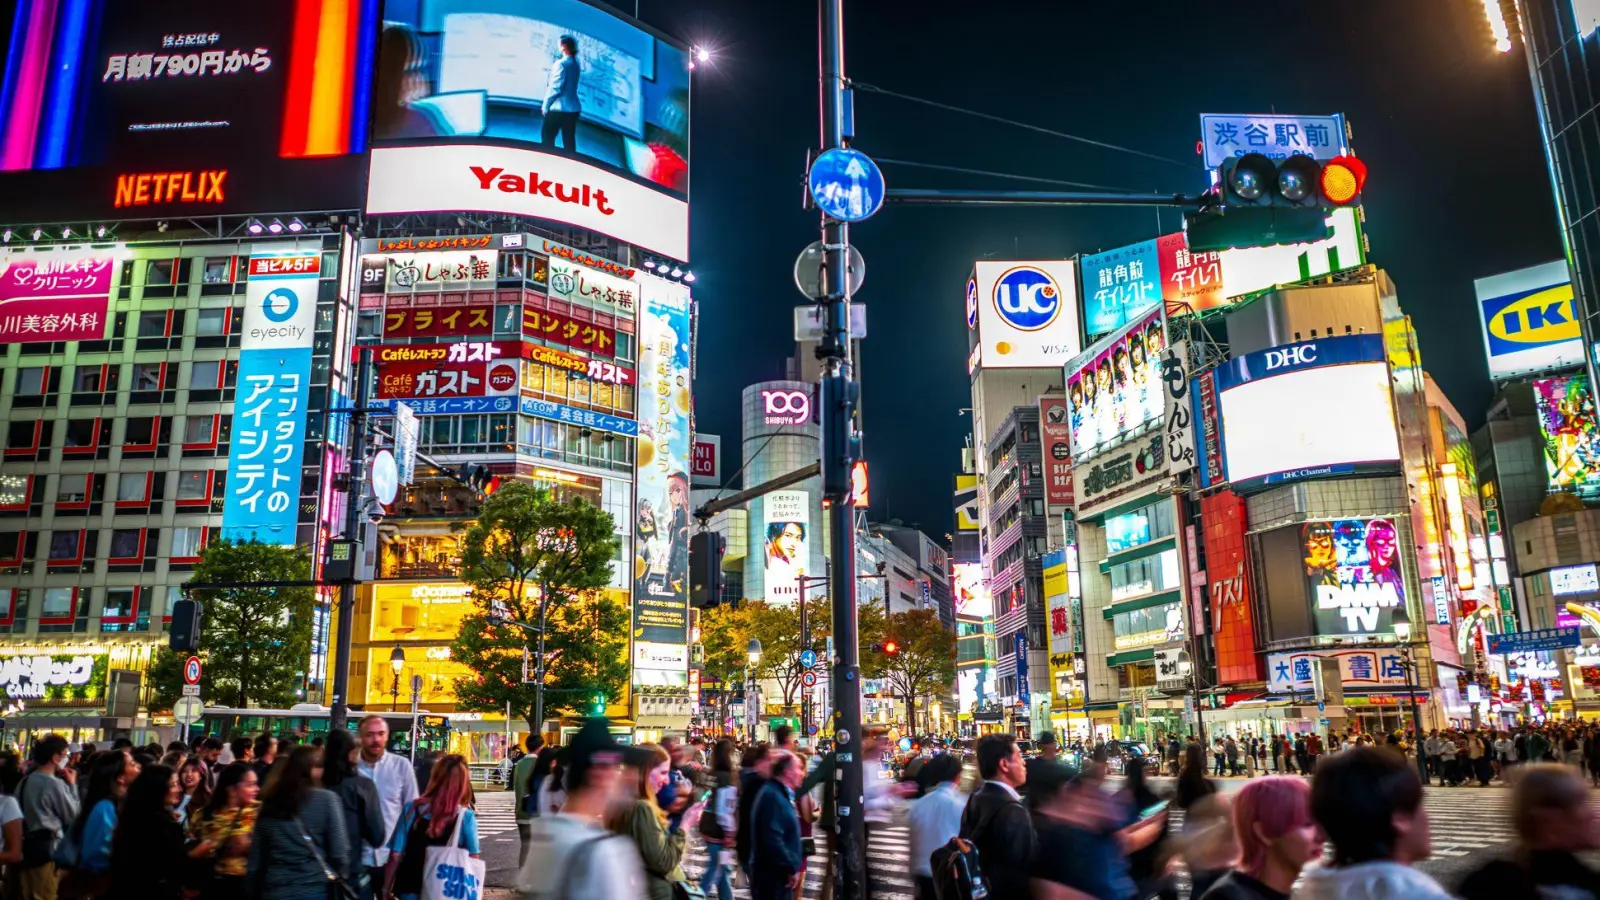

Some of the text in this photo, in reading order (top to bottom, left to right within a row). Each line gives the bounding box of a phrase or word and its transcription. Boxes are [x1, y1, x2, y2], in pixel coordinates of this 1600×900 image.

[162, 33, 220, 48] 独占配信中
[103, 48, 272, 82] 月額790円から
[1214, 123, 1329, 147] 渋谷駅前
[114, 170, 228, 208] NETFLIX
[469, 166, 615, 216] Yakult
[378, 235, 492, 252] しゃぶしゃぶバイキング
[256, 258, 313, 274] 当ビル5F
[364, 268, 384, 282] 9F
[425, 260, 490, 282] しゃぶ葉
[1098, 259, 1144, 288] 龍角散
[33, 275, 97, 291] クリニック
[580, 277, 633, 308] しゃぶ葉
[1094, 281, 1154, 309] ダイレクト
[1000, 282, 1056, 315] UC
[0, 312, 98, 334] 川美容外科
[251, 324, 306, 340] eyecity
[386, 308, 489, 332] プライス
[523, 309, 613, 348] コンタクト
[448, 342, 501, 362] ガスト
[1042, 344, 1069, 355] VISA
[1264, 344, 1317, 371] DHC
[384, 373, 412, 386] Café
[415, 369, 480, 396] ガスト
[492, 375, 514, 384] ガスト
[587, 360, 629, 384] ガスト
[526, 400, 554, 414] AEON
[560, 407, 636, 432] 英会話イーオン
[762, 390, 809, 424] 109
[1162, 349, 1196, 466] もんじゃ
[765, 416, 793, 425] SHIBUYA
[235, 374, 275, 513] アイシティ
[267, 373, 300, 513] コンタクトの
[1283, 466, 1331, 479] DHC Channel
[1212, 561, 1243, 632] クスリ
[1316, 582, 1399, 609] DMM
[1340, 606, 1380, 632] TV
[1275, 653, 1406, 682] 大盛書店
